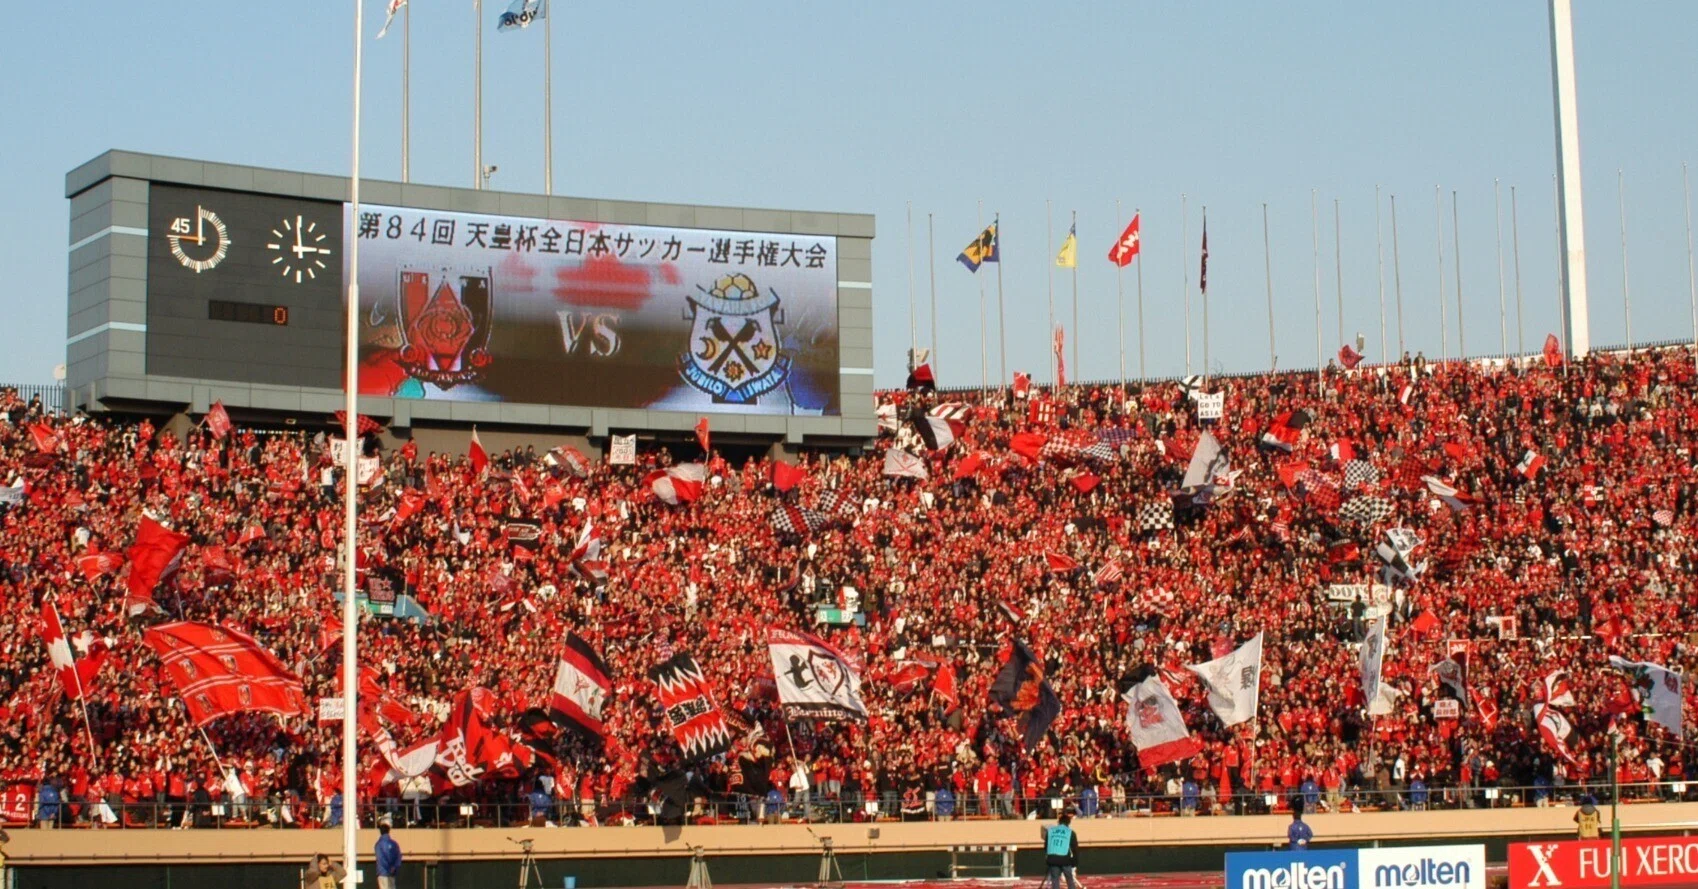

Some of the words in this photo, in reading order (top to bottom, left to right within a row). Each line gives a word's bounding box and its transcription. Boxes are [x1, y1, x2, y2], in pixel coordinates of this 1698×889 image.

[170, 218, 190, 233] 45
[465, 221, 827, 269] 天皇杯全日本サッカー選手権大会
[274, 307, 286, 324] 0
[556, 310, 621, 356] VS
[1243, 862, 1344, 889] molten
[1375, 858, 1470, 887] molten
[1579, 846, 1628, 879] FUI
